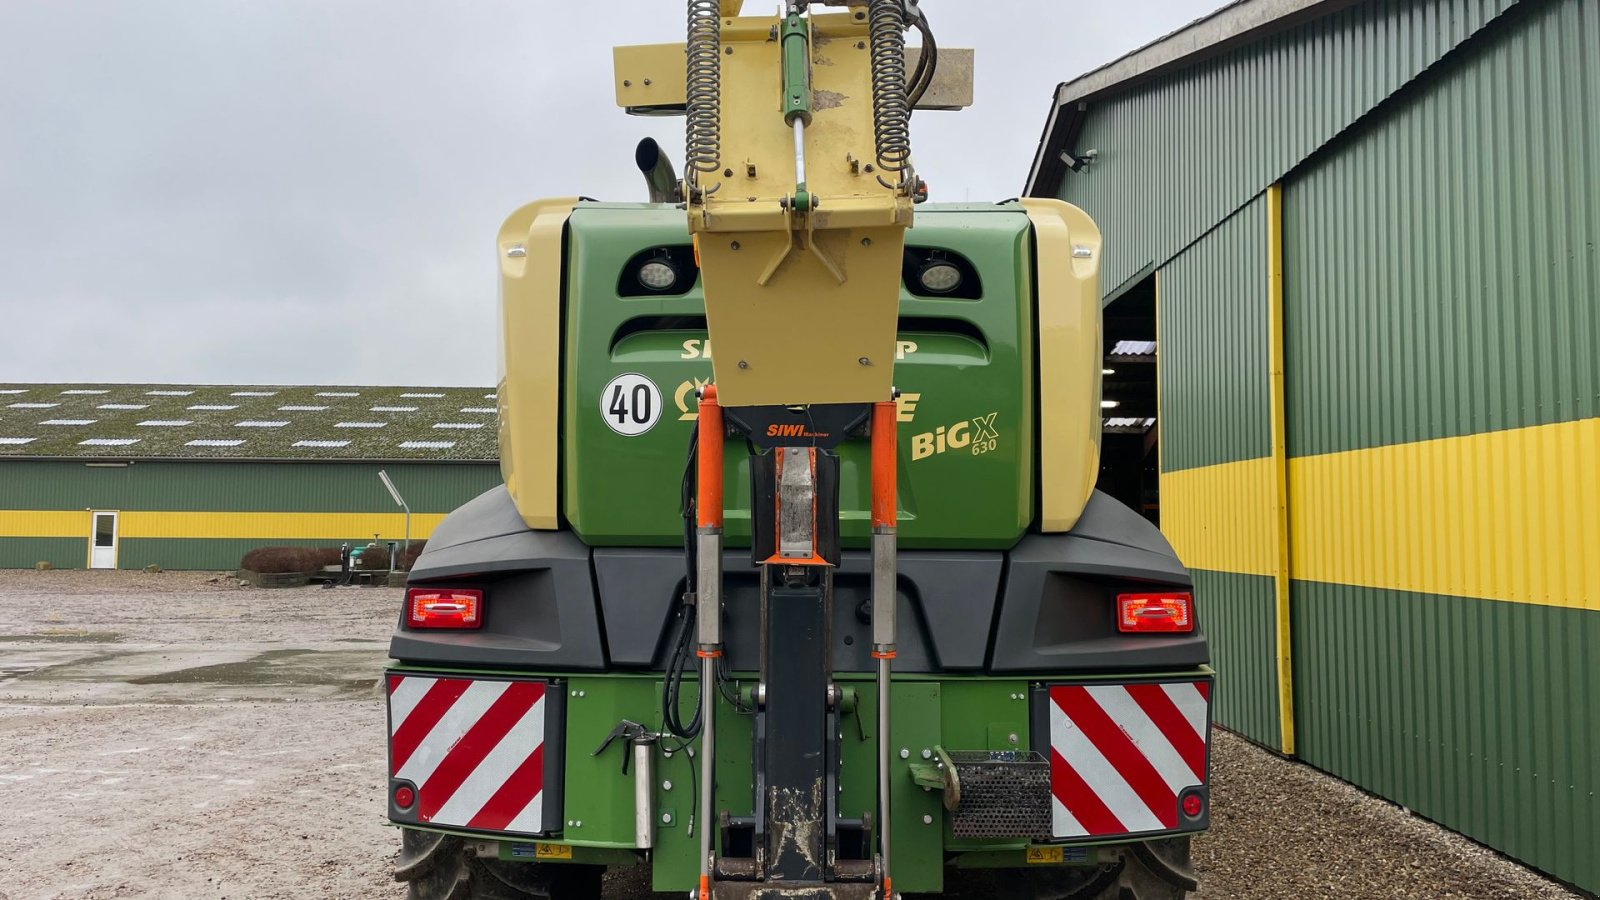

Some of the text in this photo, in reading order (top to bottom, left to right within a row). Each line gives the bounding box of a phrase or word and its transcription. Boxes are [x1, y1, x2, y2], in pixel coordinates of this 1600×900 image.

[609, 384, 651, 424] 40
[766, 424, 805, 437] SIWI
[971, 438, 997, 456] 630
